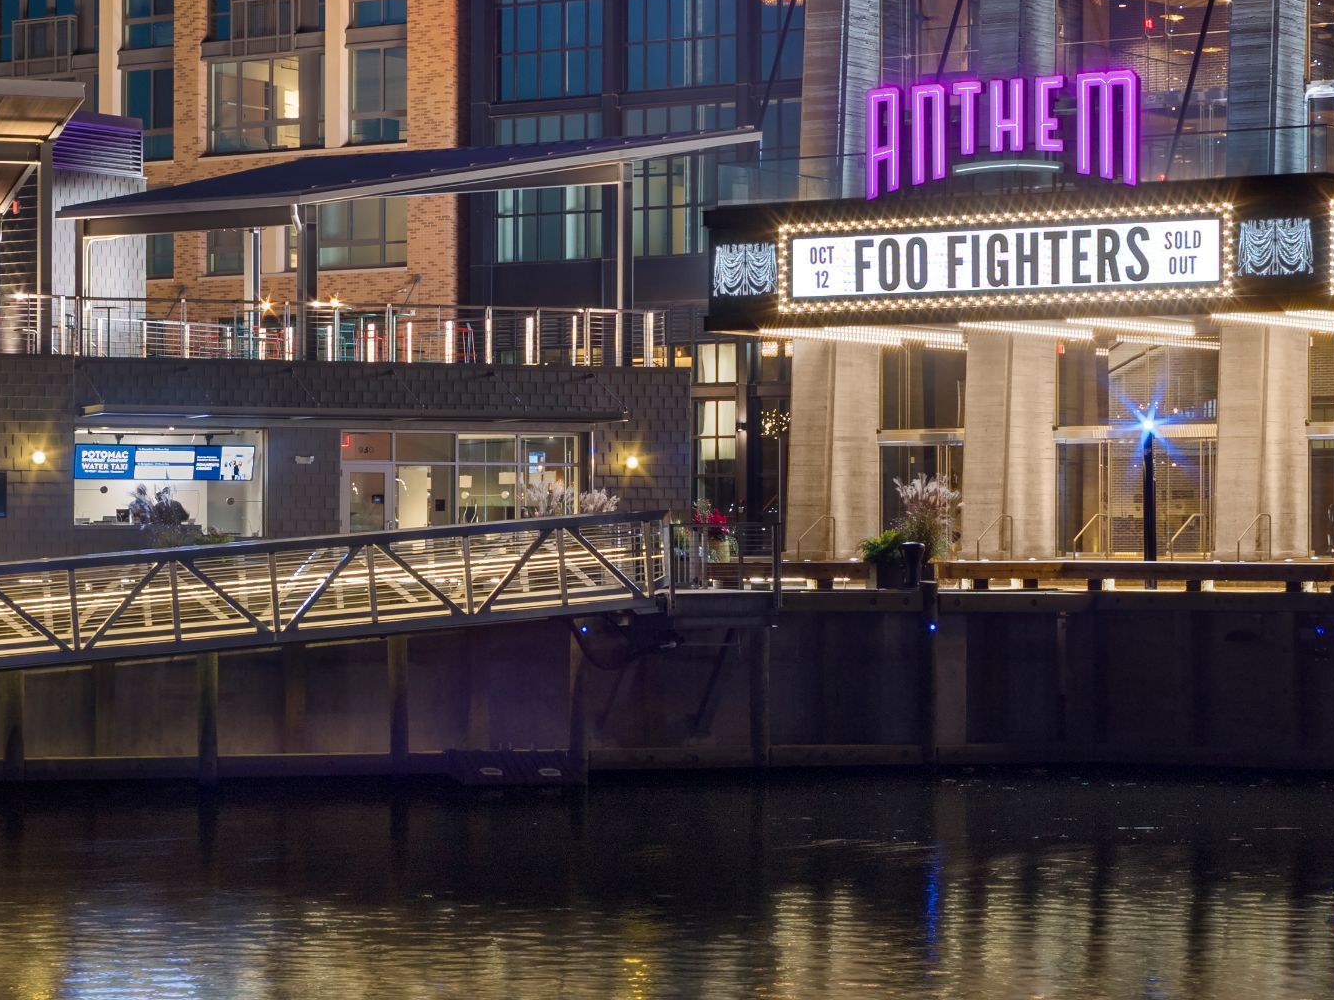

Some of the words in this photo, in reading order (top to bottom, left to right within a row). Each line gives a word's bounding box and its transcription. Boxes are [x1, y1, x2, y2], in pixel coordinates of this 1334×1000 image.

[866, 69, 1137, 200] ANTHEM
[1164, 230, 1202, 250] SOLD
[809, 245, 835, 265] OCT
[854, 236, 928, 292] FOO
[947, 226, 1150, 289] FIGHTERS
[1169, 256, 1197, 275] OUT
[815, 270, 829, 289] 12
[81, 450, 129, 459] POTOMAC
[81, 462, 108, 470] WATER
